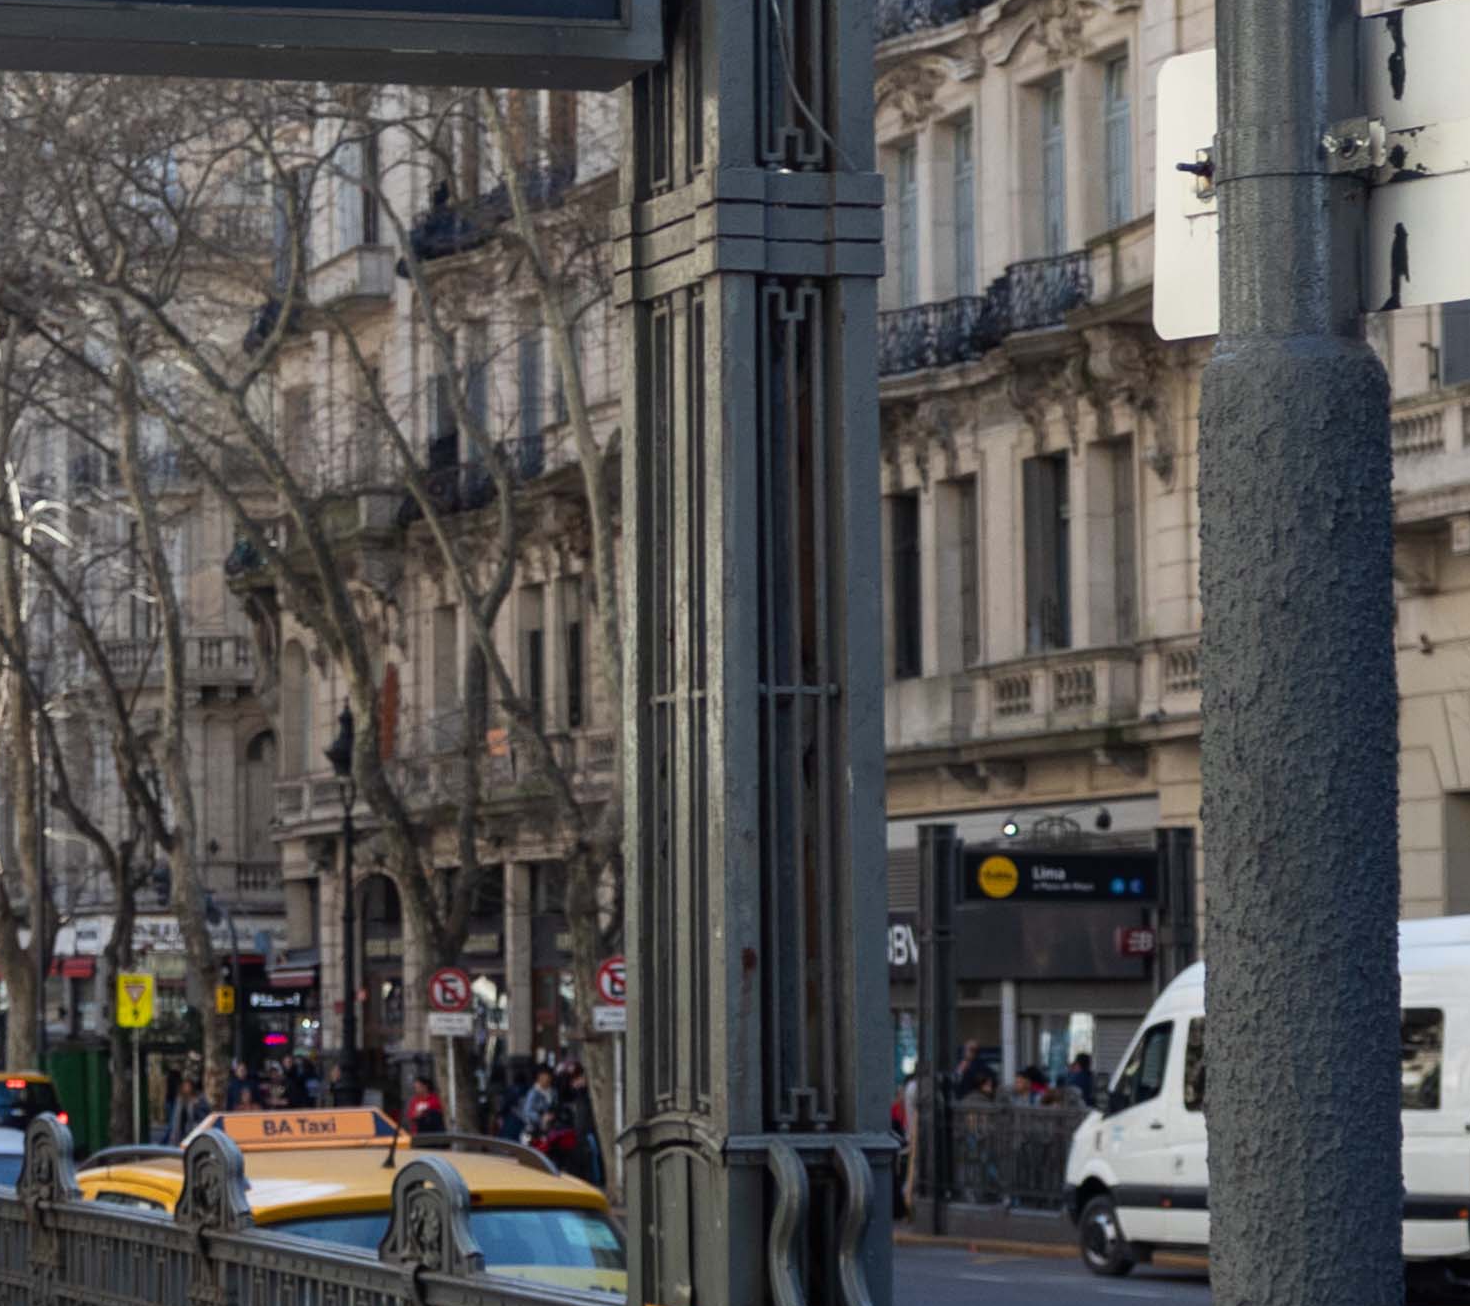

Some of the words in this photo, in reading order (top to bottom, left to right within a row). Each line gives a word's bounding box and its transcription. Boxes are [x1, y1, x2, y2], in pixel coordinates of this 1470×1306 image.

[1031, 865, 1066, 881] Lima
[262, 1119, 291, 1137] BA
[293, 1116, 337, 1136] Taxi
